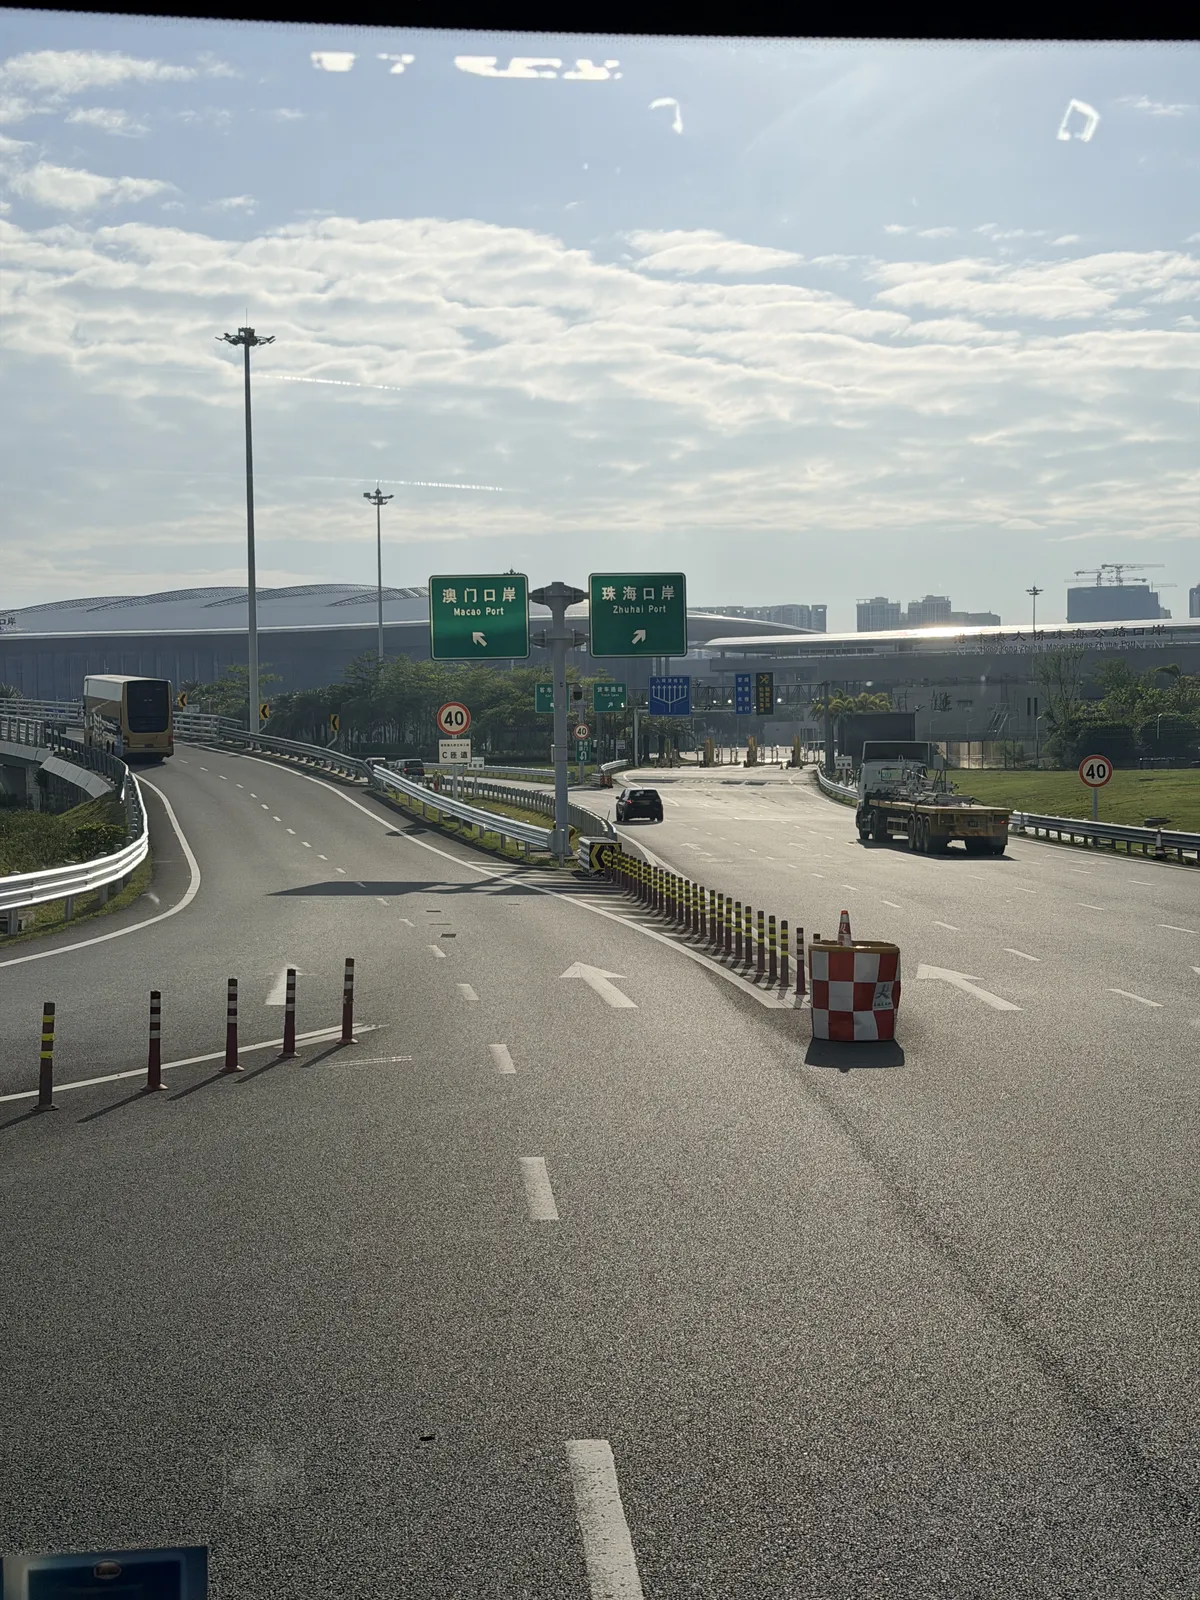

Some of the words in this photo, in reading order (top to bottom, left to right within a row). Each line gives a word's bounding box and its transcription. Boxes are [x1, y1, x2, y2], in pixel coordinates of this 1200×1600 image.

[442, 587, 516, 603] 澳门口岸
[601, 585, 675, 601] 珠海口岸
[453, 607, 482, 616] Macao
[485, 606, 505, 616] Port
[612, 604, 644, 614] Zhuhai
[648, 604, 667, 614] Port
[444, 711, 464, 727] 40
[577, 728, 587, 736] 40
[1086, 764, 1106, 779] 40
